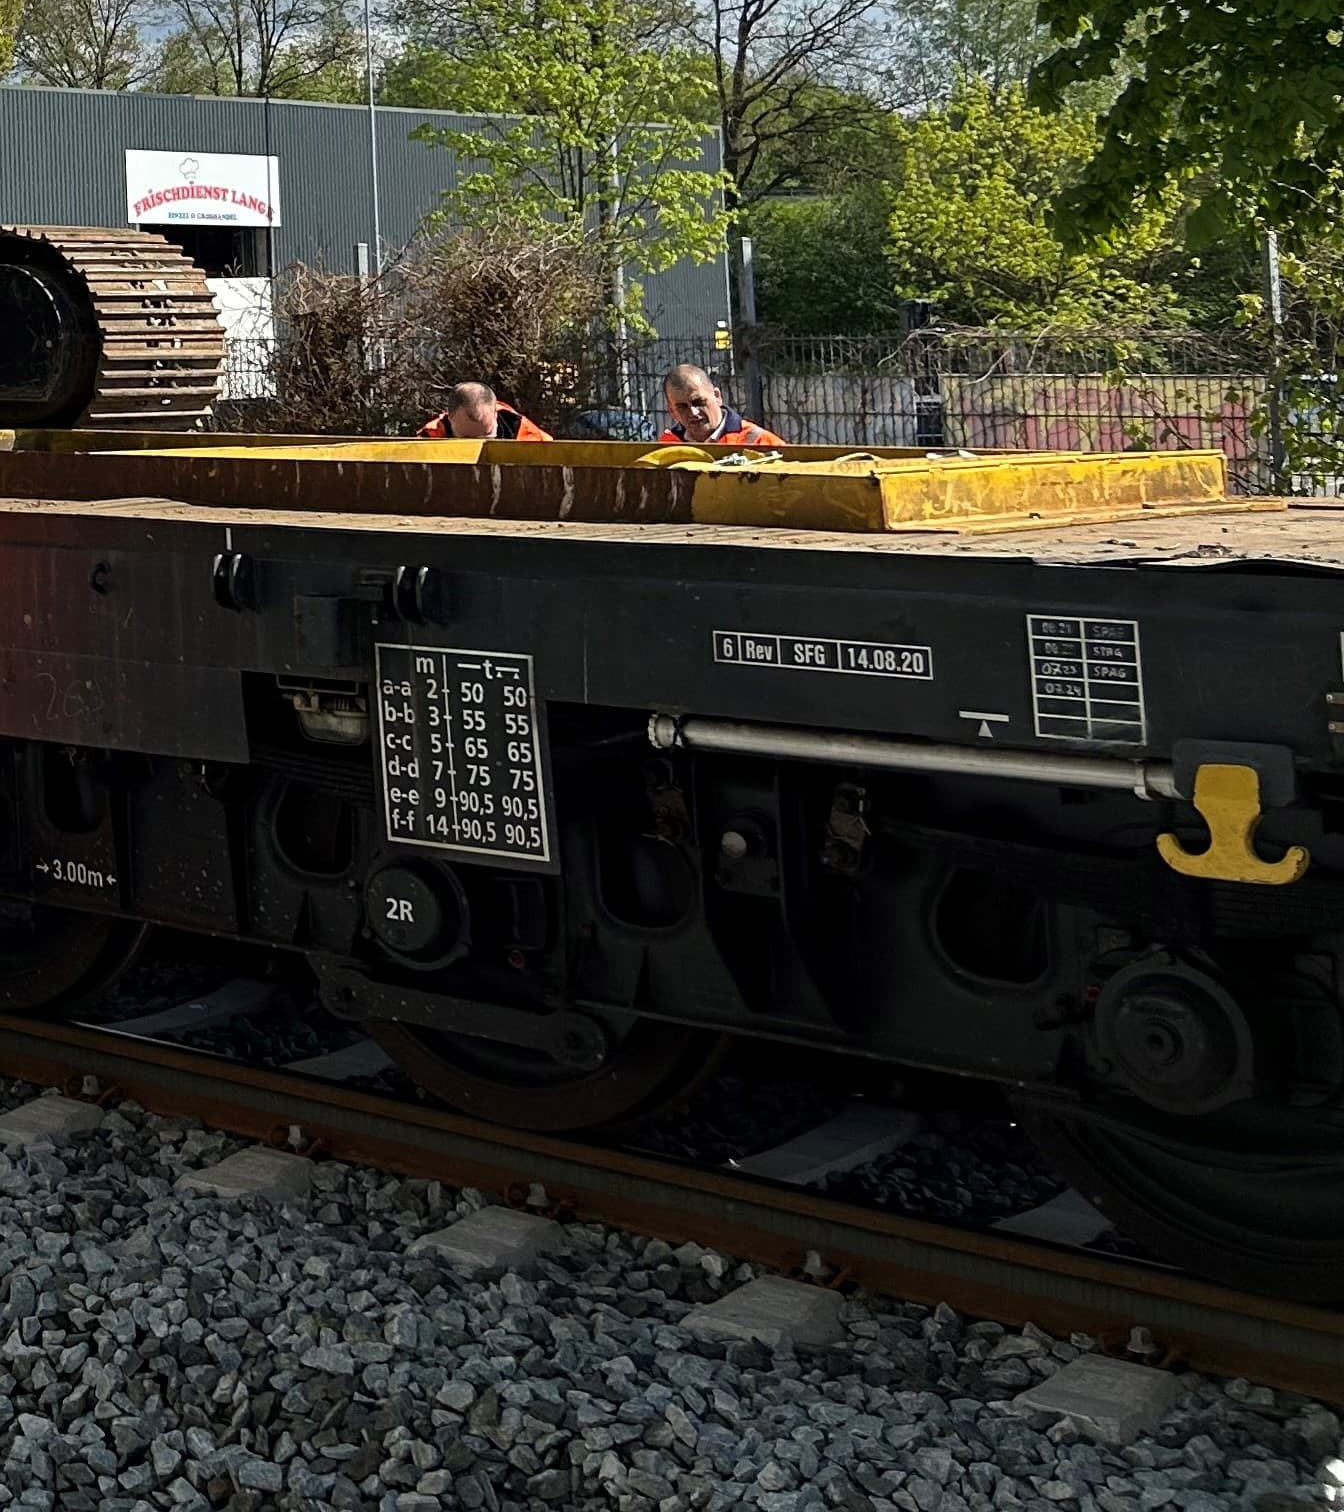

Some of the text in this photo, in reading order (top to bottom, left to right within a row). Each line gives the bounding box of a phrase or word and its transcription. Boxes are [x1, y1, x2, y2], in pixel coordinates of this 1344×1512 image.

[415, 656, 494, 680] m t
[723, 638, 924, 674] 6 Rev SFG 14.08.20
[382, 679, 527, 708] a-a 2 50 50
[384, 700, 530, 735] b-b 3 55 55
[386, 733, 533, 763] c-c 5 65 65
[388, 755, 535, 792] d-d 7 75 75
[390, 787, 538, 821] e-e 9 90,5 90,5
[392, 809, 541, 849] f-f 14 90,5 90,5
[52, 858, 104, 888] 3.00m
[385, 897, 414, 925] 2R
